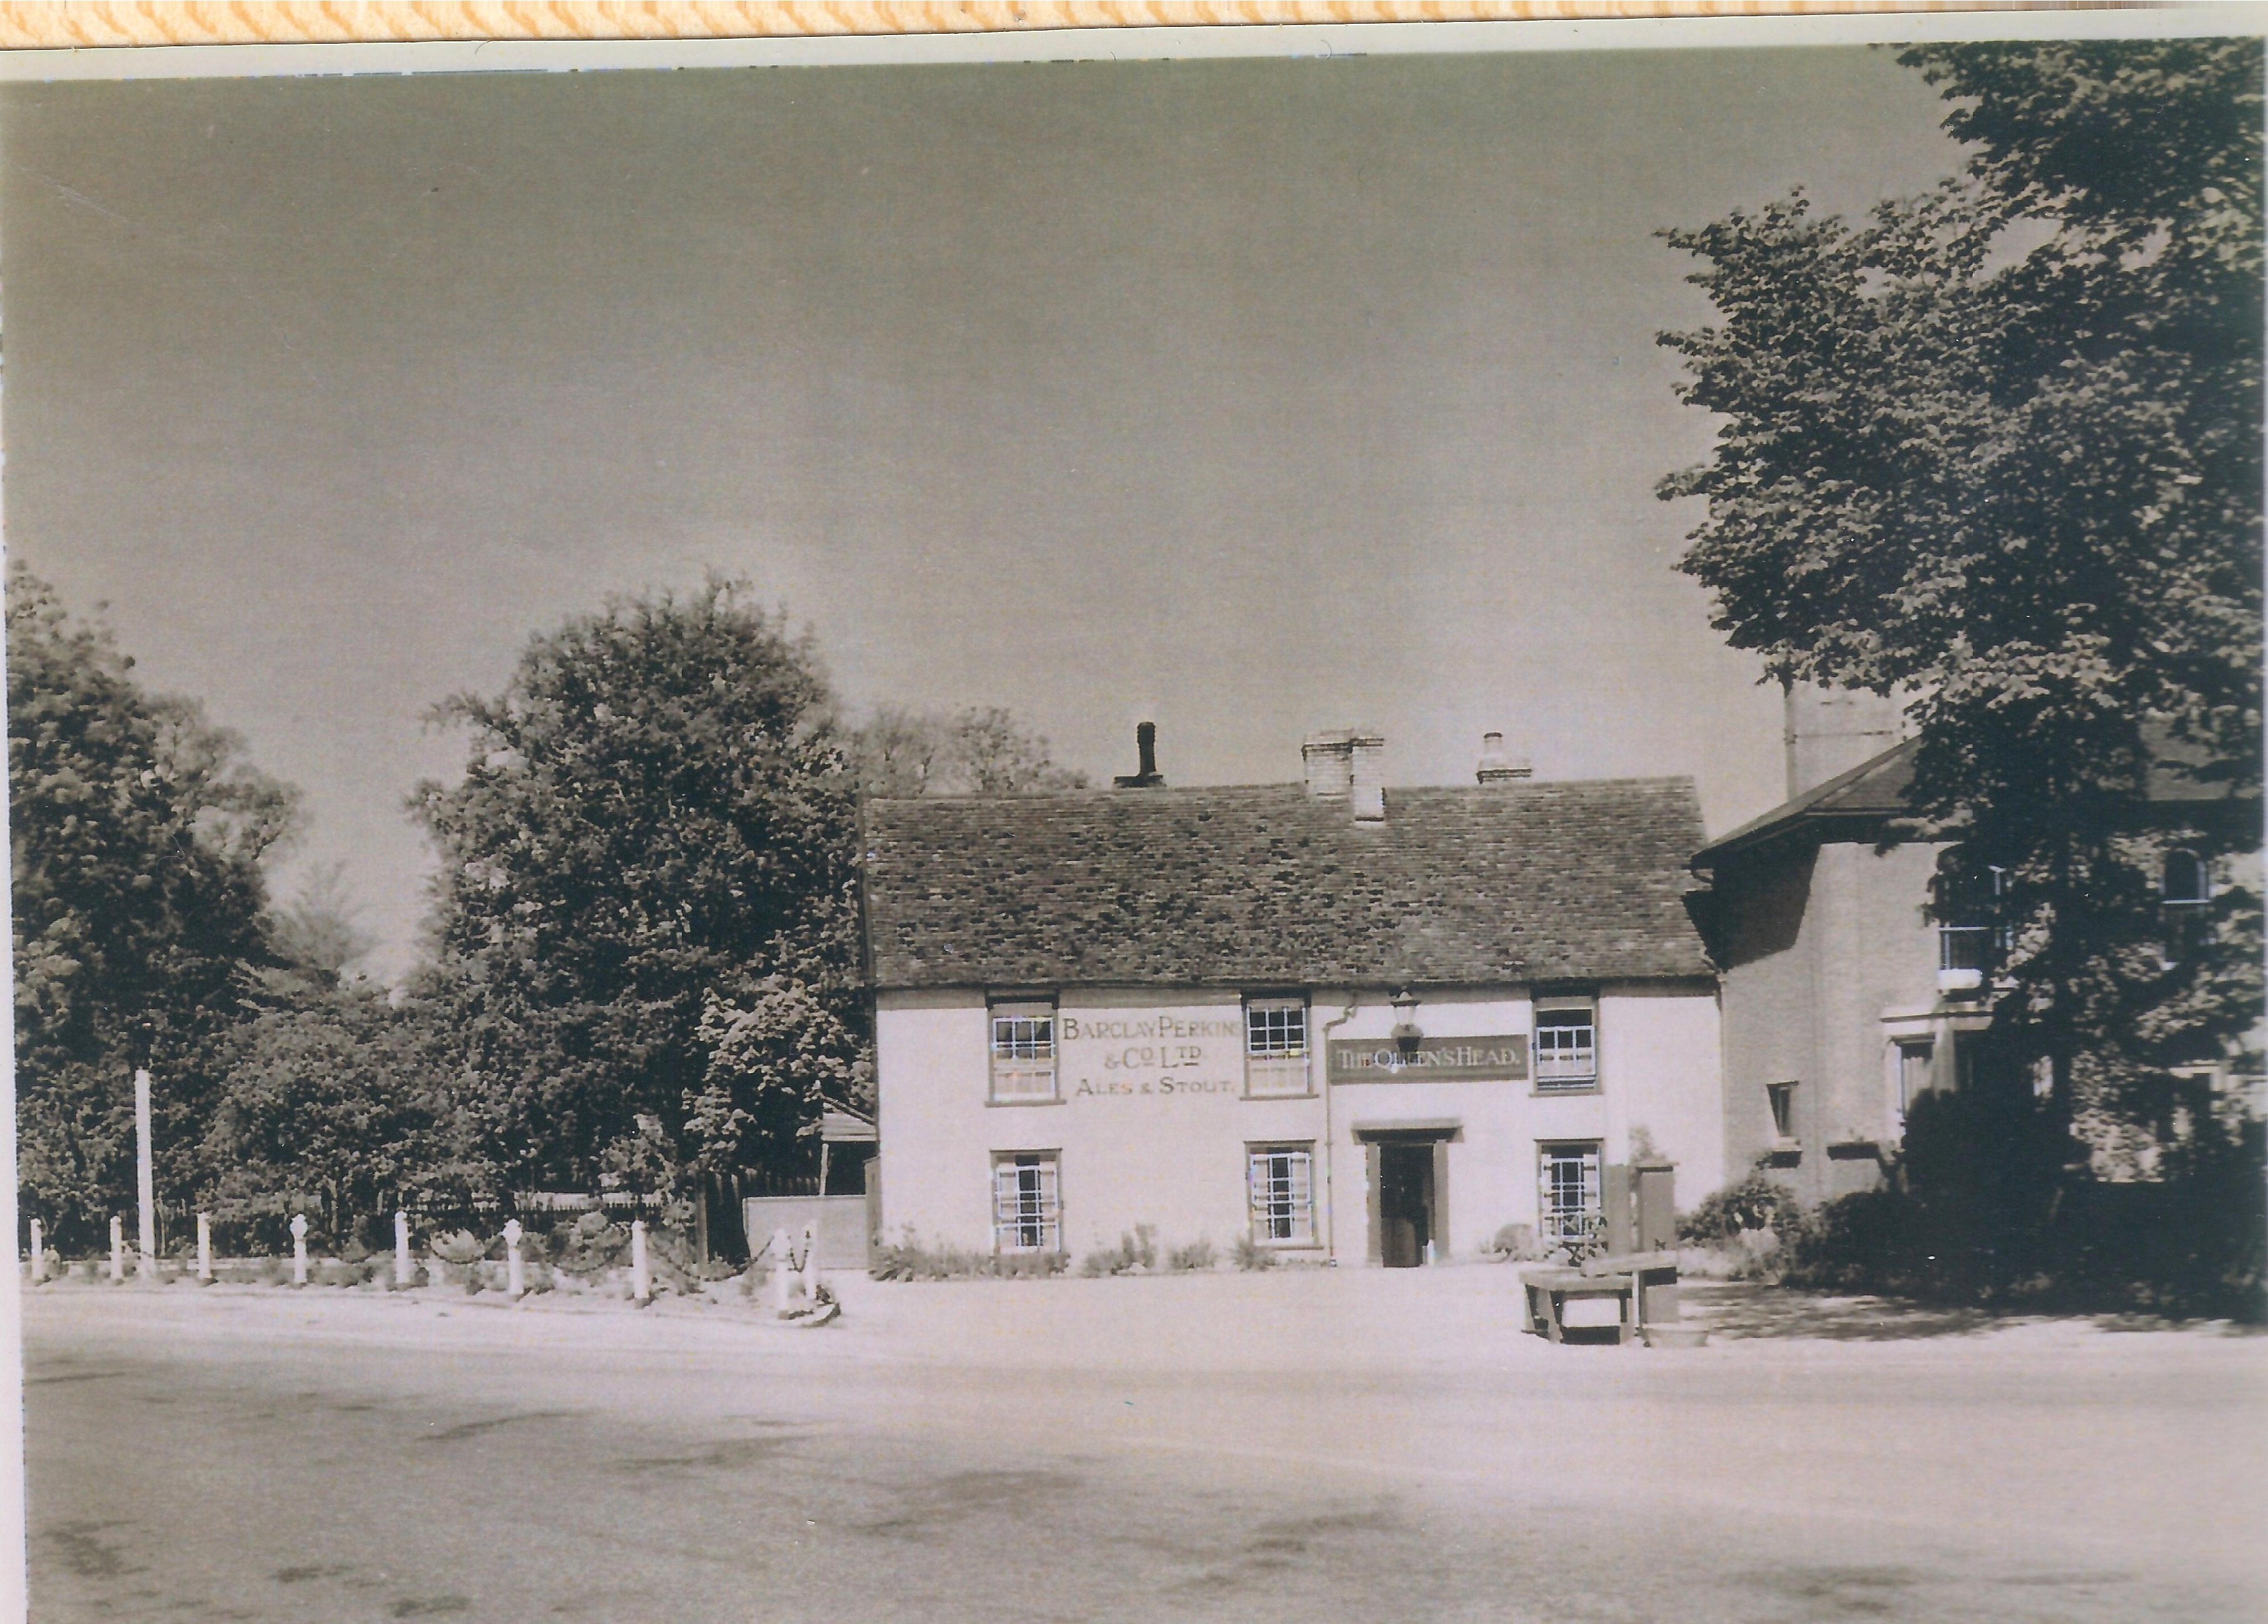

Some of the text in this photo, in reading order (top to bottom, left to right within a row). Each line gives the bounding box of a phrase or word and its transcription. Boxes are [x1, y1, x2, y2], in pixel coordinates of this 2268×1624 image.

[1063, 1017, 1157, 1040] BARCLAY
[1105, 1052, 1121, 1069] &
[1336, 1049, 1374, 1069] THE
[1076, 1078, 1133, 1097] ALES
[1140, 1082, 1153, 1094] &
